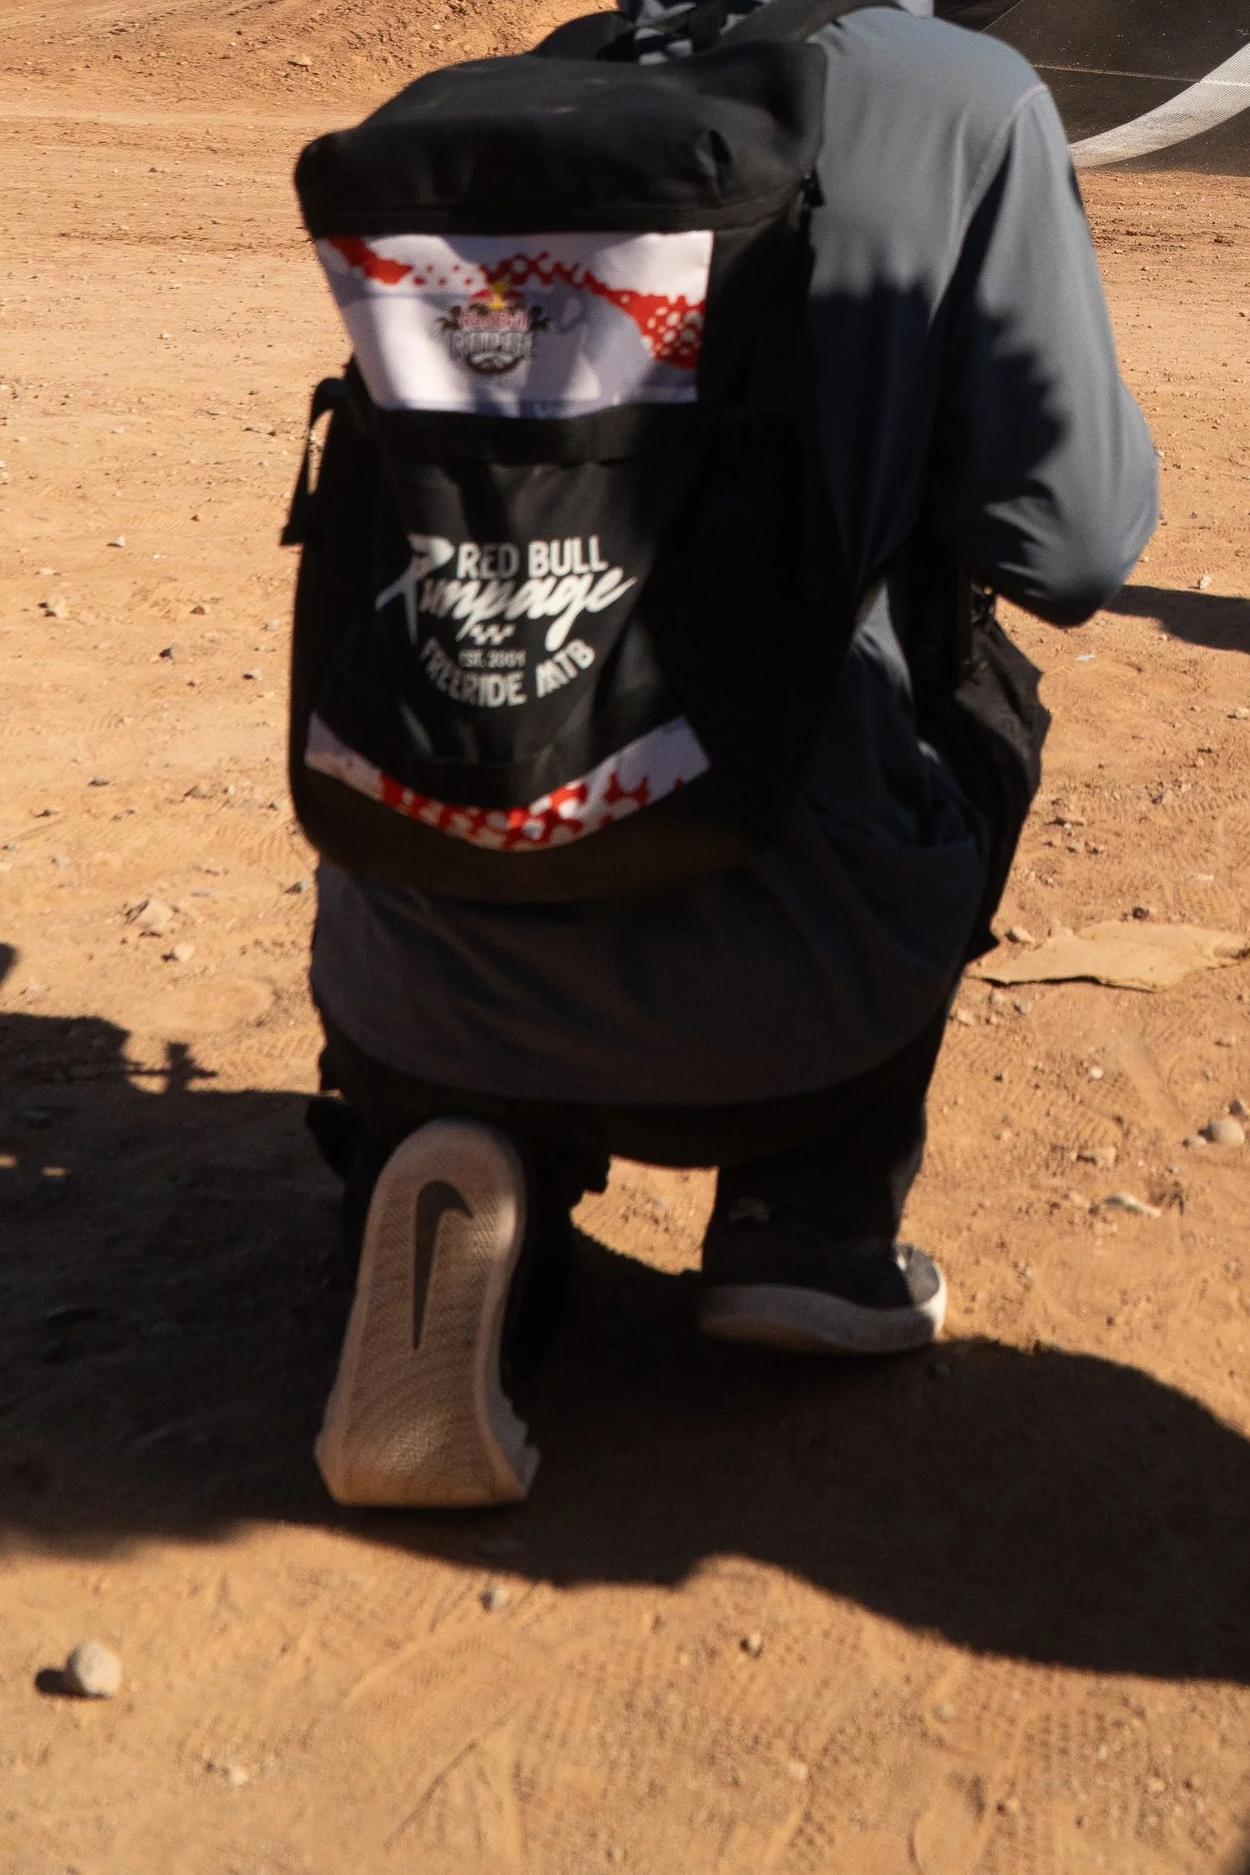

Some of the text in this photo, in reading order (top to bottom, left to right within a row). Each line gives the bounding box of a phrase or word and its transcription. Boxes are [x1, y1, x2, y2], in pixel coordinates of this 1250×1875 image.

[375, 532, 638, 651] Rampage
[456, 535, 608, 579] RED BULL
[419, 636, 595, 707] FREERIDE MTB
